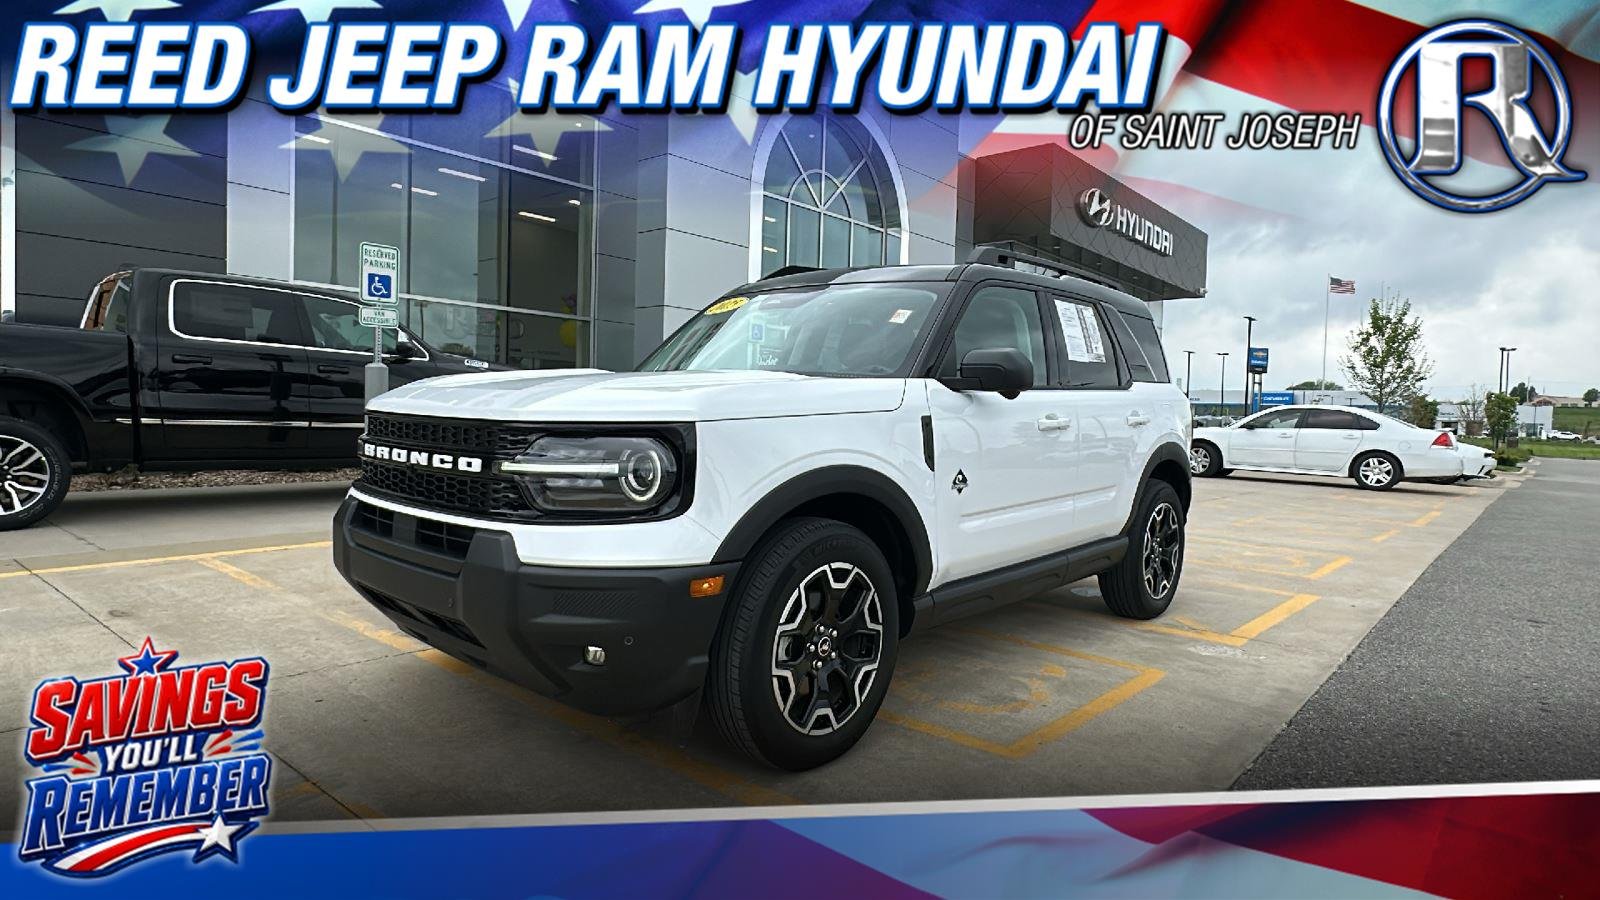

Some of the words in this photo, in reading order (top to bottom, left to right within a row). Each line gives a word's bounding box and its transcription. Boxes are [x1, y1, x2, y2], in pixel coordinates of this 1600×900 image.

[1116, 204, 1174, 256] HYUNDAI
[364, 248, 396, 260] RESERVED
[364, 258, 396, 271] PARKING
[364, 443, 483, 473] BRONCO
